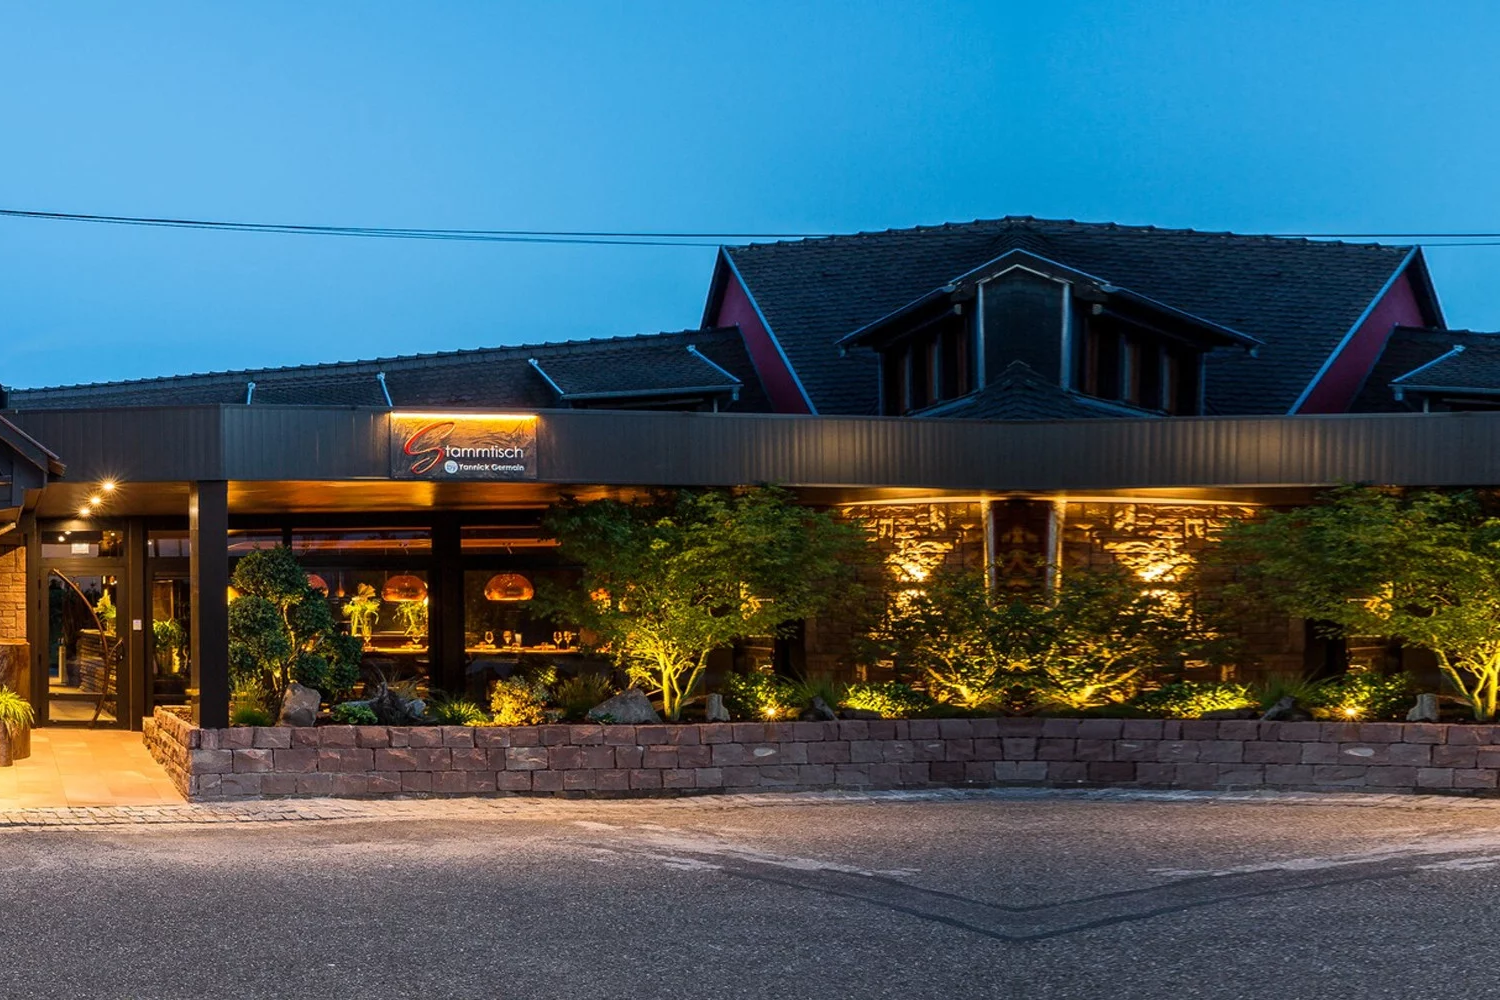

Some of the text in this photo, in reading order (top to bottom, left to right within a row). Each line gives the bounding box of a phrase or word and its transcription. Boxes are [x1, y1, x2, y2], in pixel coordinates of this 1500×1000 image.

[404, 422, 524, 474] Stammtisch
[459, 463, 490, 471] Yannick
[491, 463, 525, 471] Germain
